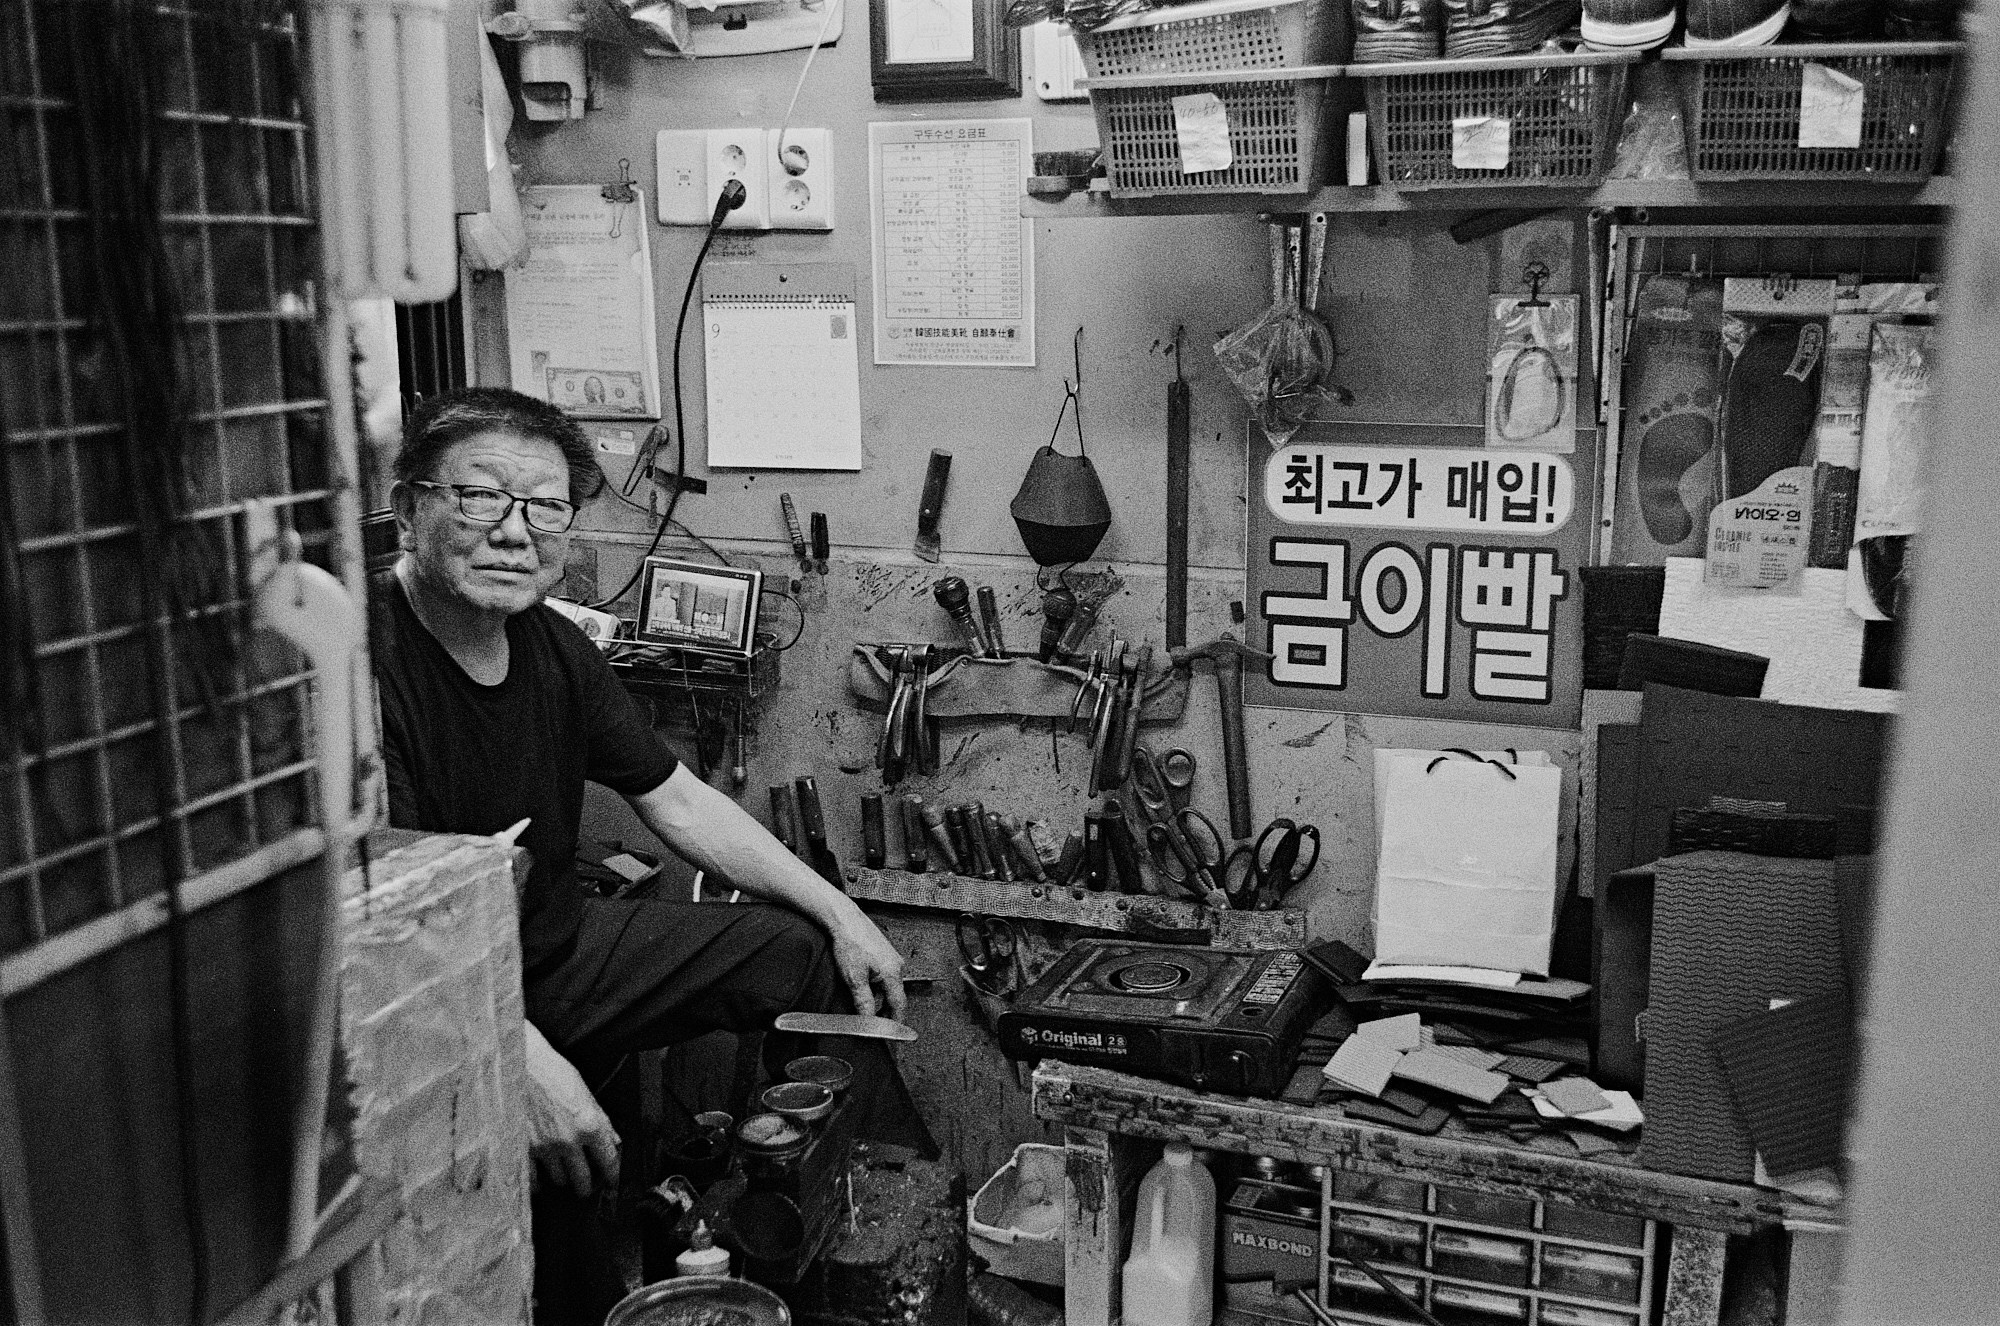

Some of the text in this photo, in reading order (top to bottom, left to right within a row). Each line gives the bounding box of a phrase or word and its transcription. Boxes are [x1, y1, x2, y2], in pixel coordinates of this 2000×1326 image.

[914, 128, 986, 140] 구두수선 요금표
[711, 323, 721, 338] 9
[1282, 454, 1557, 524] 최고가 매입!
[1261, 536, 1569, 705] 금이빨
[1041, 1029, 1103, 1047] Original
[1232, 1231, 1313, 1258] MAXBOND
